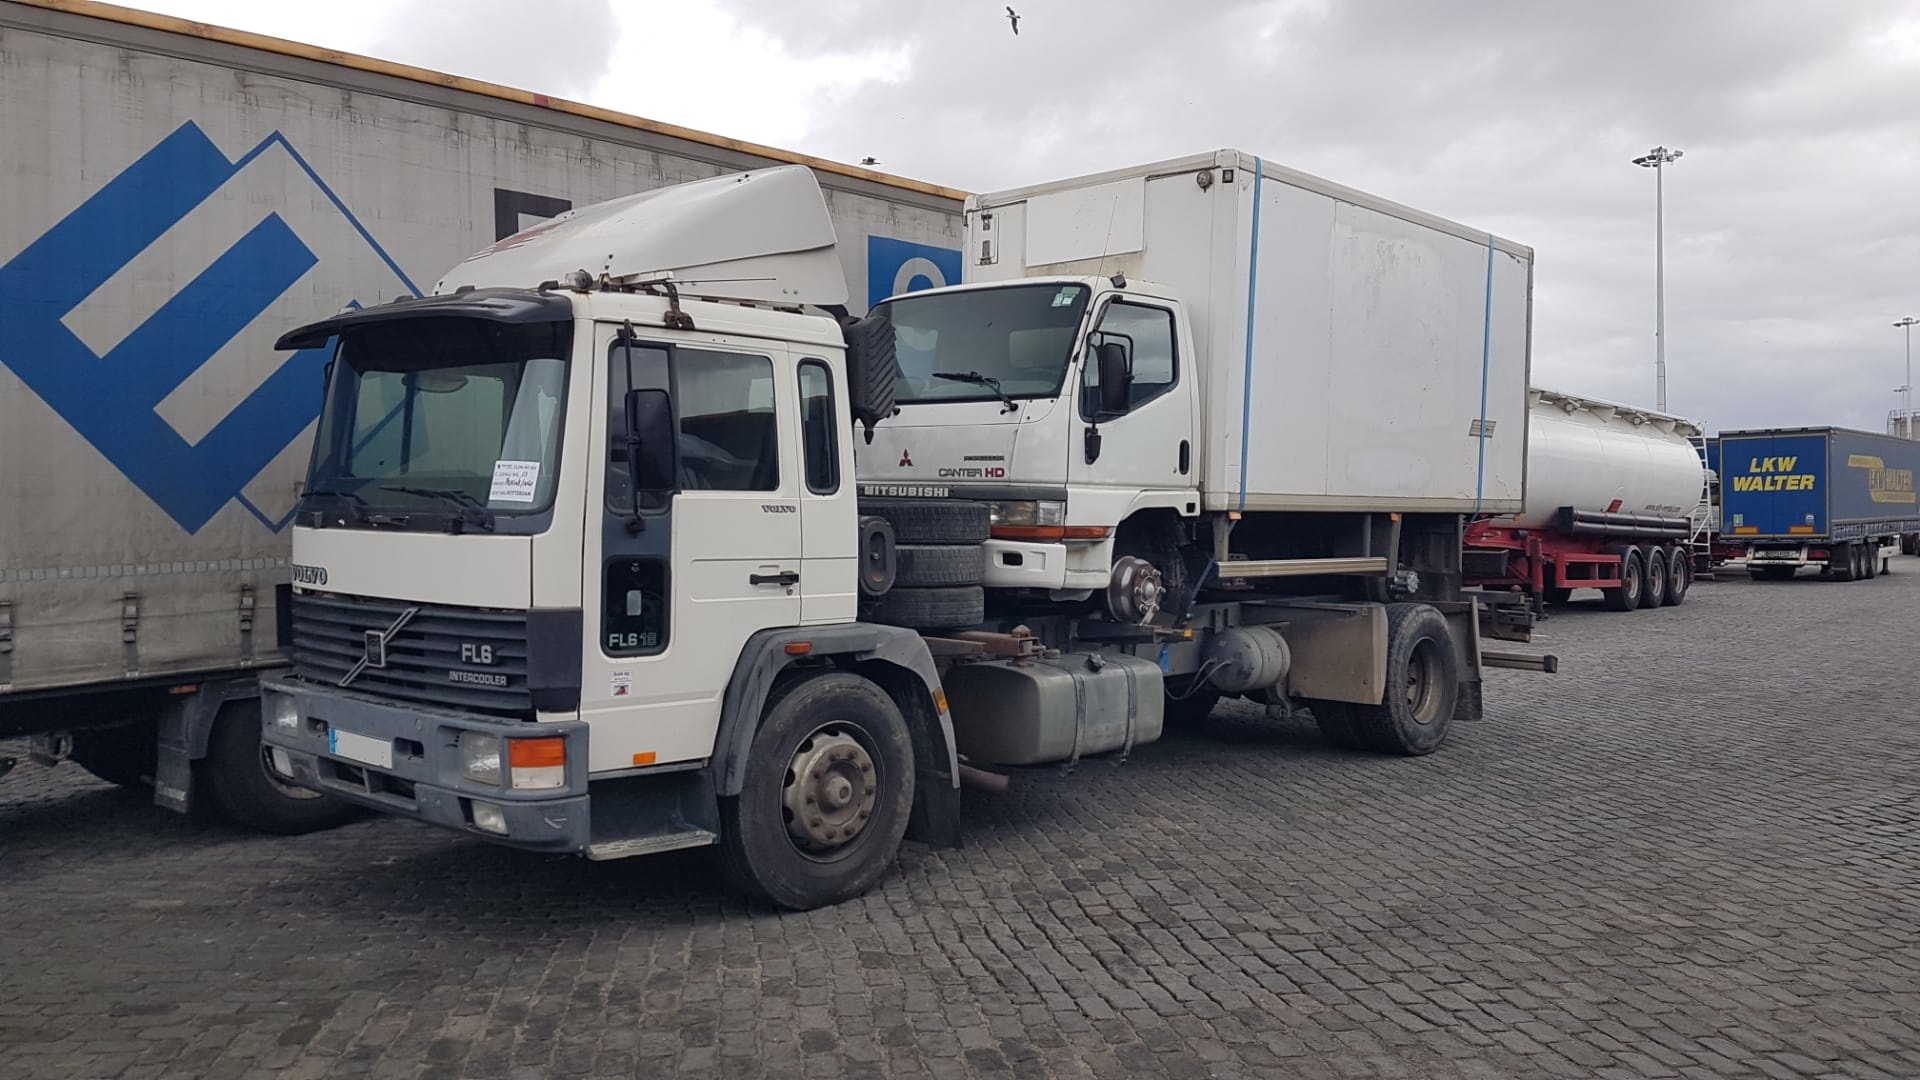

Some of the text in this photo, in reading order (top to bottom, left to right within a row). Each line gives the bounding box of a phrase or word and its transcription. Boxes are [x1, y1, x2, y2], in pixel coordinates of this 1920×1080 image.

[938, 467, 1005, 478] CANTER HD
[1750, 456, 1798, 473] LKW
[1733, 474, 1815, 492] WALTER
[864, 486, 949, 497] MITSUBISHI
[761, 504, 796, 513] VOLVO
[291, 564, 328, 586] VOLVO
[462, 644, 492, 664] FL6
[449, 671, 507, 686] INTERCOOLER
